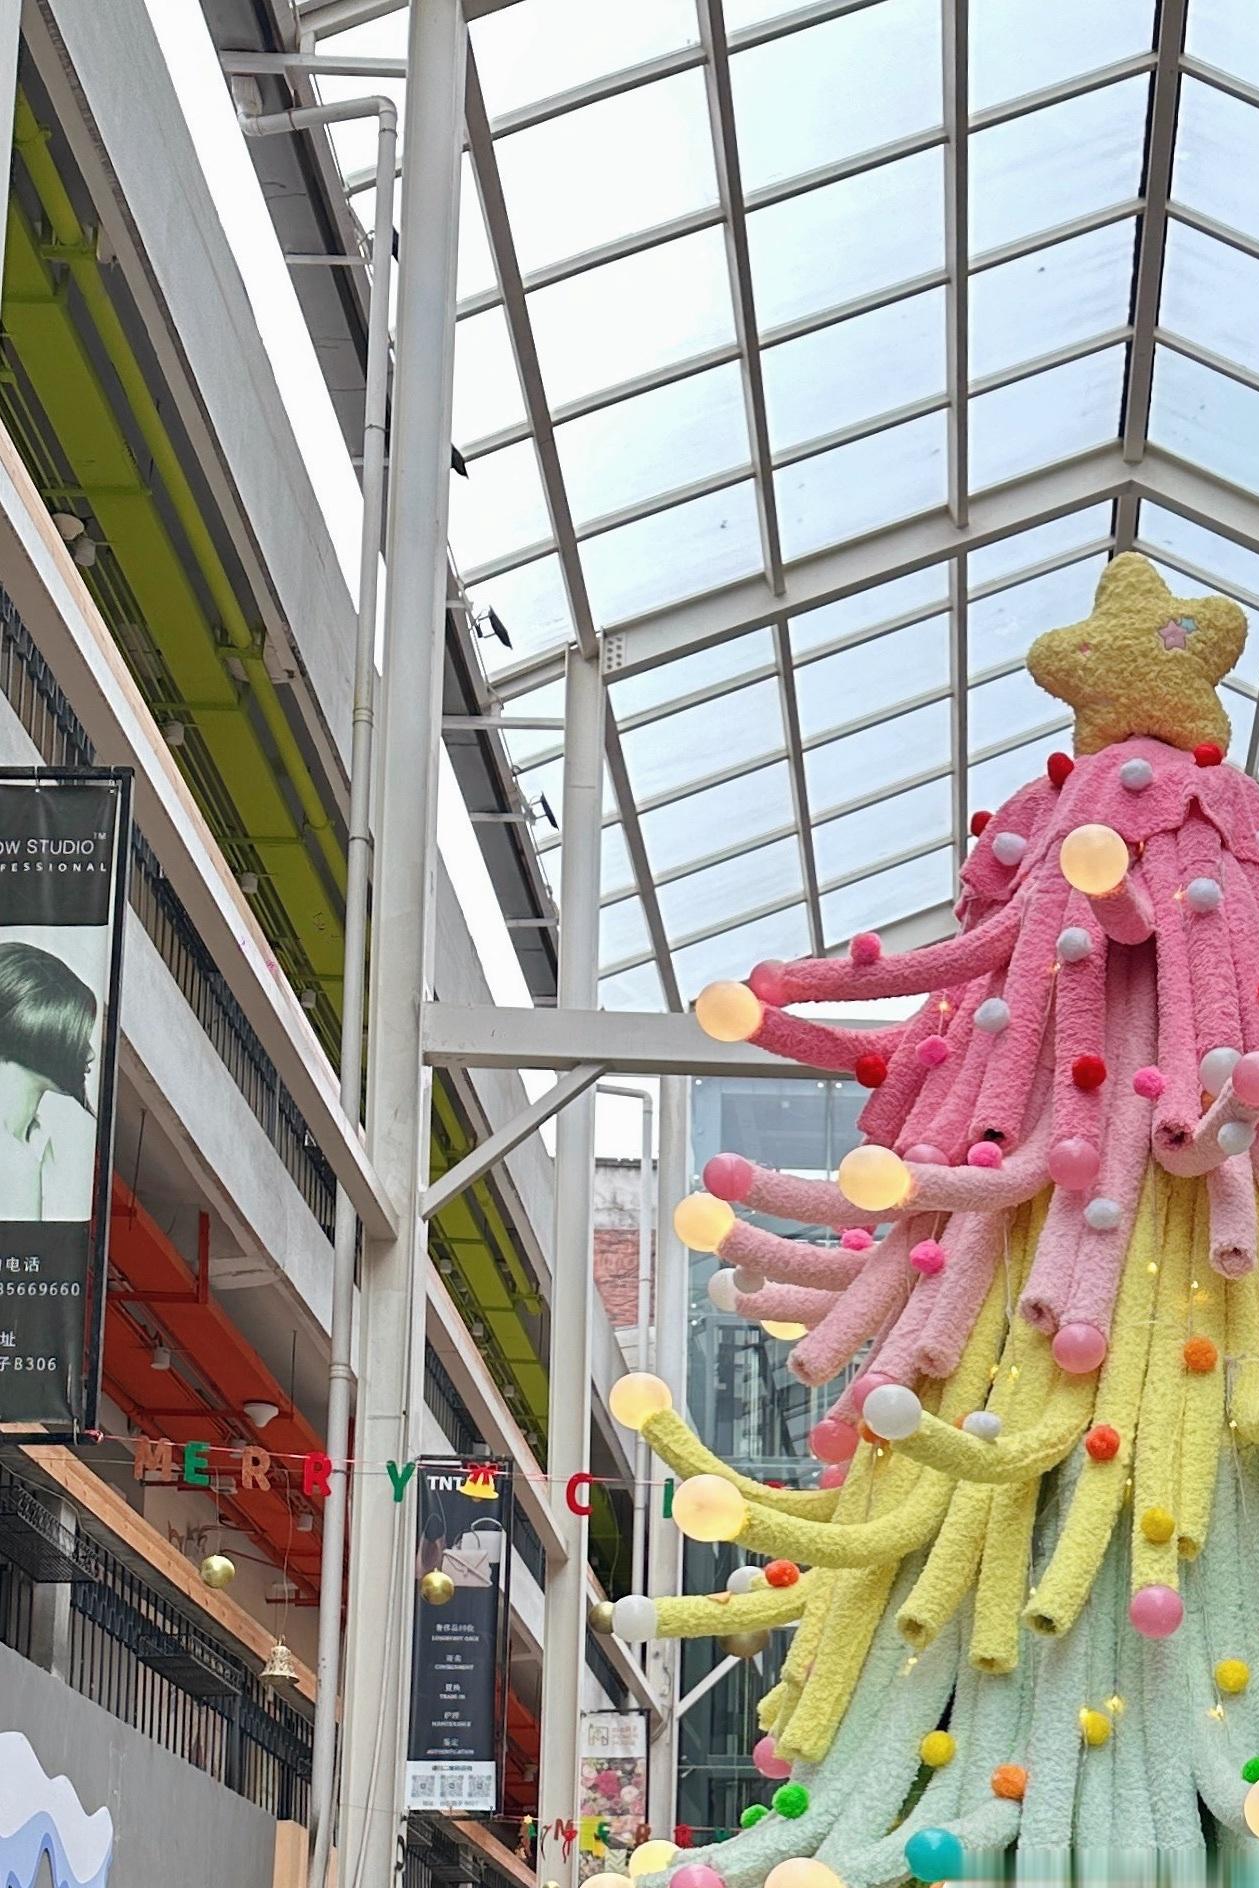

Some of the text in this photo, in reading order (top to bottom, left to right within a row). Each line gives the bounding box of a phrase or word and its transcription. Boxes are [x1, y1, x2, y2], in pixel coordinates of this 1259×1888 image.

[27, 839, 94, 855] STUDIO
[0, 862, 107, 872] FESSIONAL
[0, 1256, 40, 1273] 电话
[133, 1434, 416, 1503] MERRY
[427, 1475, 461, 1491] TNT
